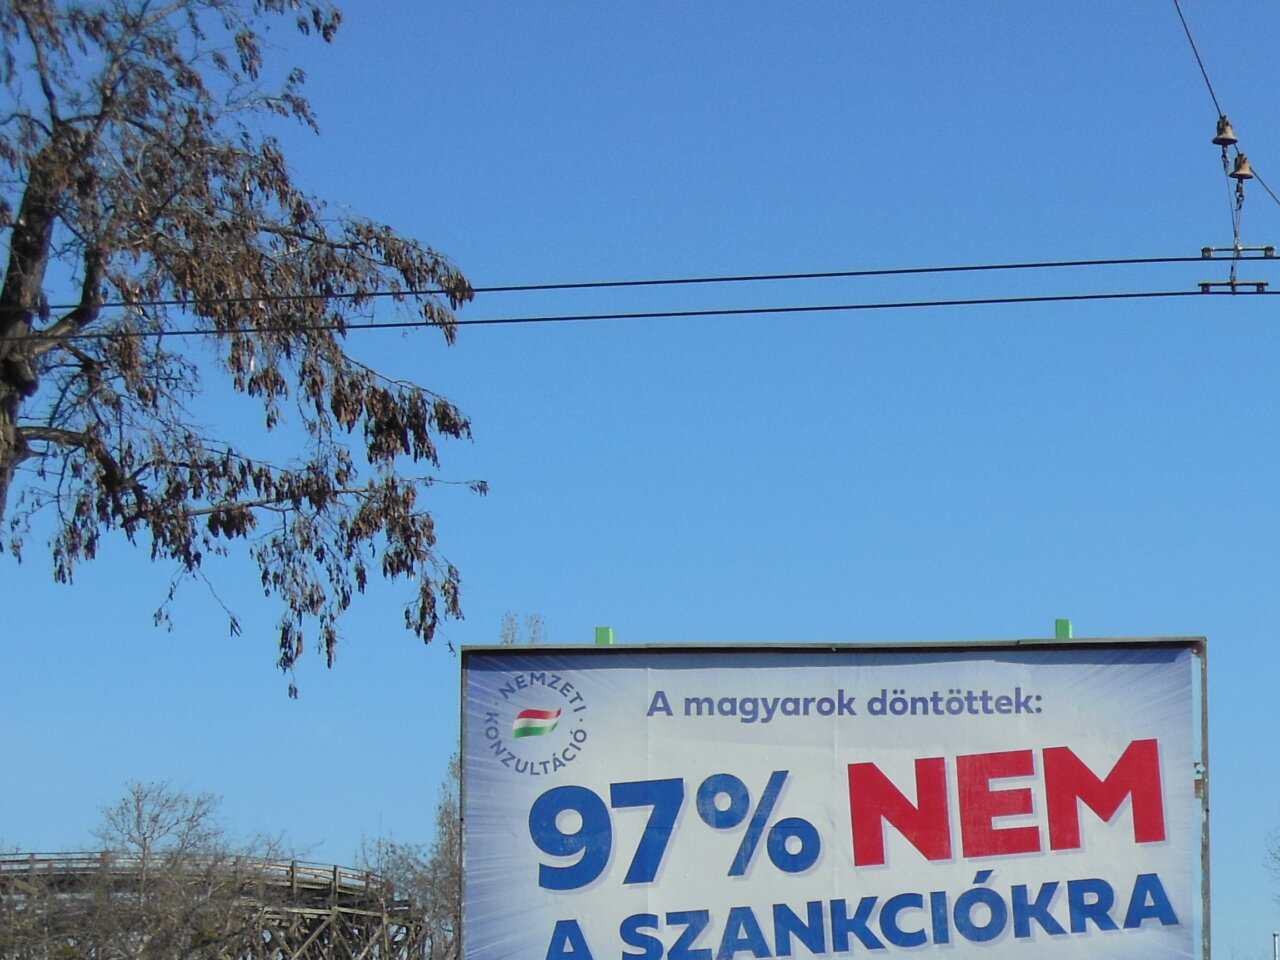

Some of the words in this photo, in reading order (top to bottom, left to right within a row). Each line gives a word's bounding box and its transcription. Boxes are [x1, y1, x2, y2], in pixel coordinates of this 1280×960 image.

[498, 672, 587, 713] NEMZETI
[646, 690, 674, 717] A
[684, 689, 857, 724] magyarok
[867, 687, 1042, 716] döntöttek:
[485, 711, 588, 776] KONZULTÁCIÓ
[528, 770, 821, 891] 97%
[847, 739, 1165, 867] NEM
